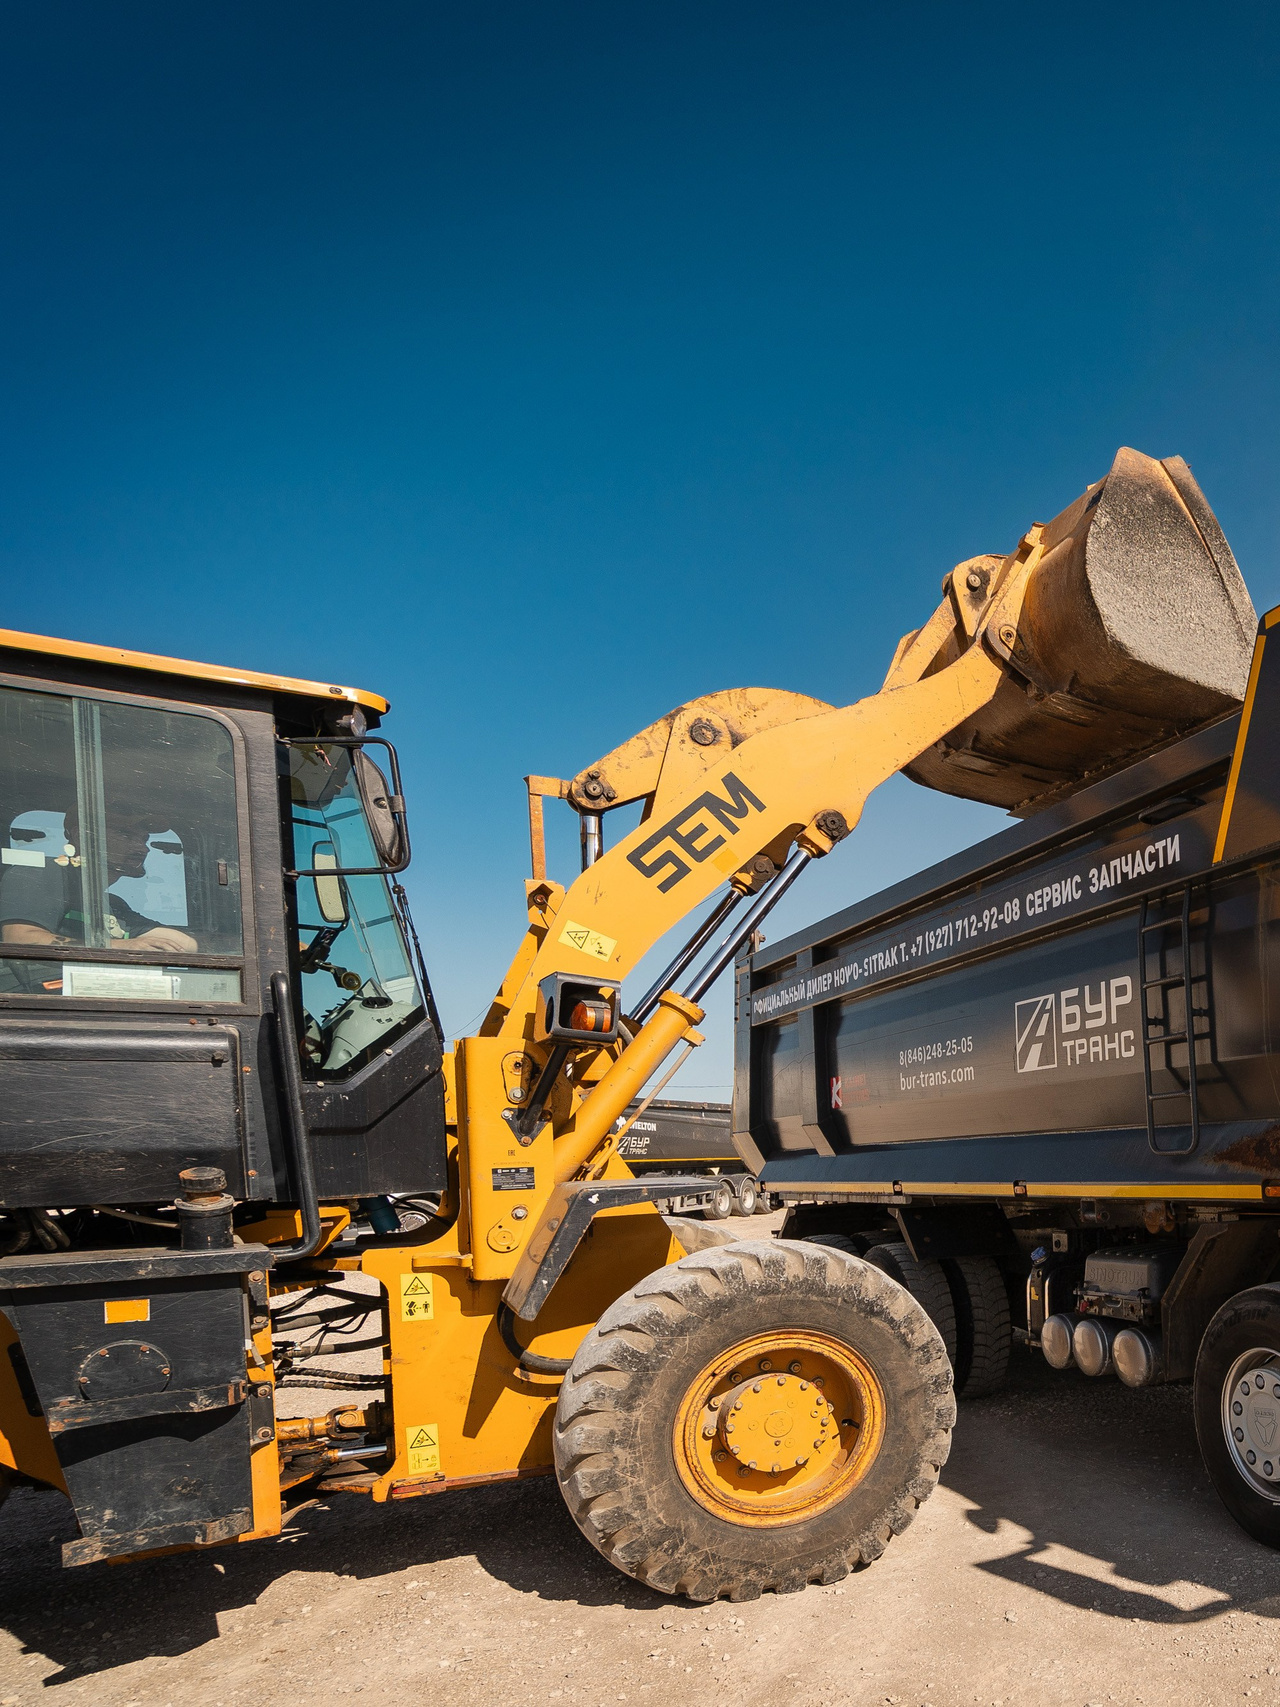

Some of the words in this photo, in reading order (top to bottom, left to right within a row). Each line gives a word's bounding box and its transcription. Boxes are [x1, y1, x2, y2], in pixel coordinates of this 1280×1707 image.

[626, 771, 767, 894] SEM
[806, 972, 833, 1000] ДИЛЕР
[910, 935, 923, 957] +7
[925, 921, 954, 955] (927)
[955, 897, 1021, 942] 712-92-08
[1025, 874, 1082, 917] СЕРВИС
[1088, 833, 1181, 894] ЗАПЧАСТИ
[1060, 975, 1133, 1033] БУР
[899, 1035, 973, 1068] 8(846)248-25-05
[1062, 1029, 1135, 1066] ТРАНС
[899, 1066, 975, 1091] bur-trans.com
[630, 1136, 650, 1148] БУР
[1088, 1266, 1144, 1285] SINOTRUK
